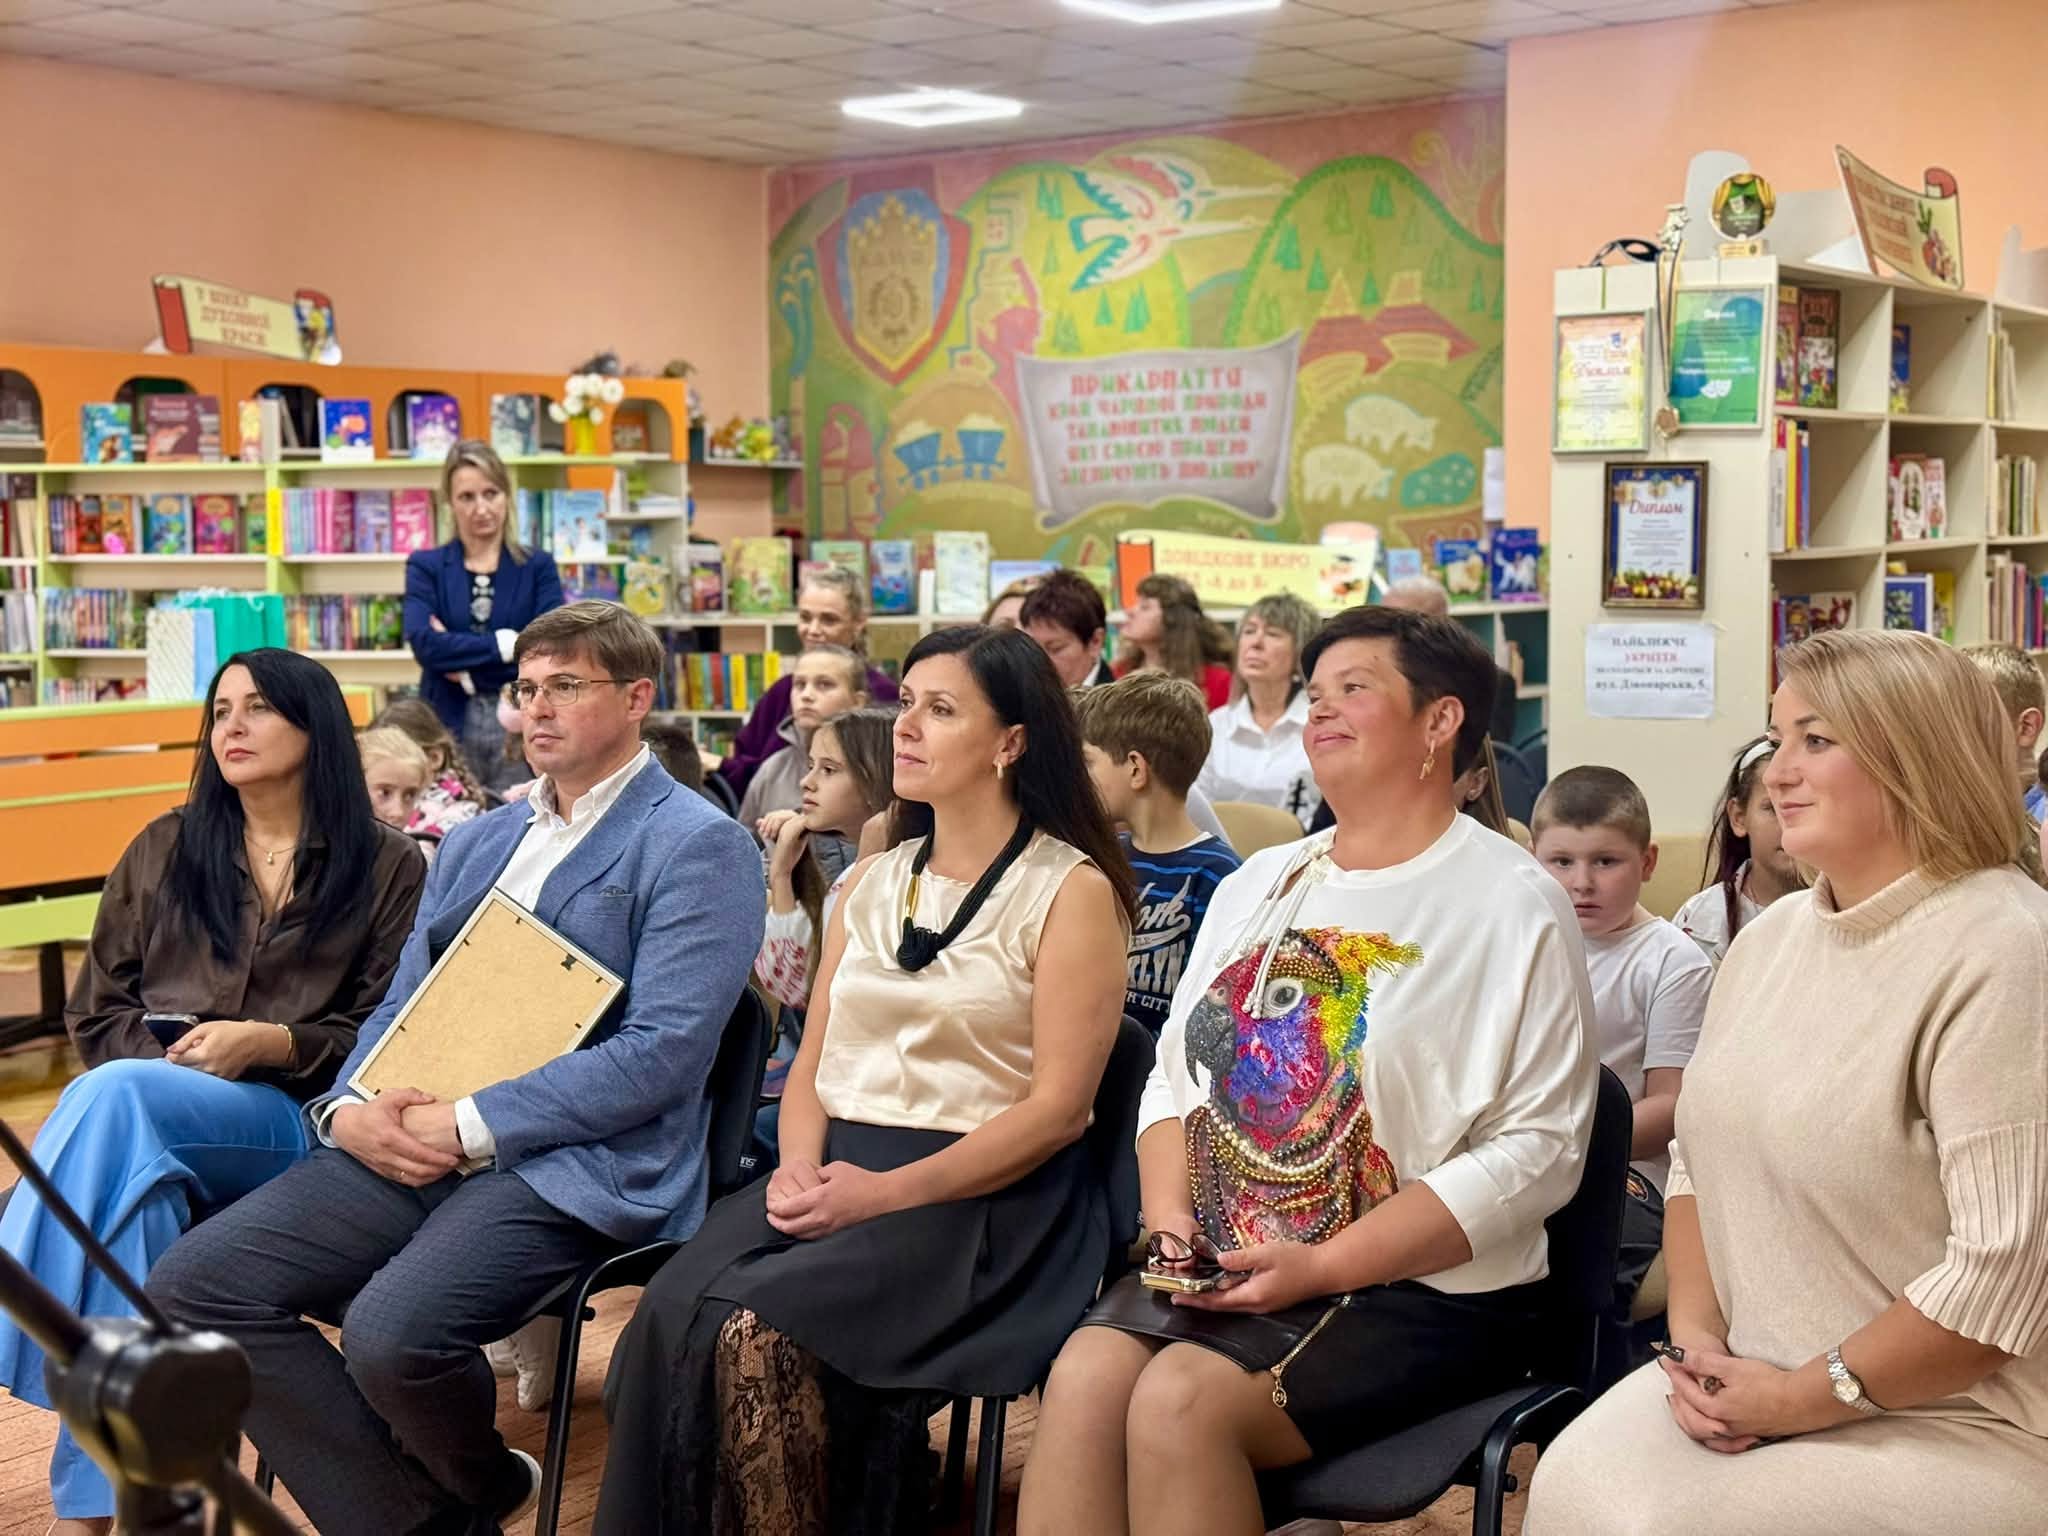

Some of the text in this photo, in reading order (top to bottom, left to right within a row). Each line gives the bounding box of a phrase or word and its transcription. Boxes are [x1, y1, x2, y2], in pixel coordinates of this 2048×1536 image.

[1070, 367, 1243, 396] ПРИКАРПАТТЯ
[1628, 500, 1685, 515] Диплом
[1611, 634, 1688, 648] НАЙБЛИЖЧЕ
[1625, 651, 1679, 664] УКРИТТЯ
